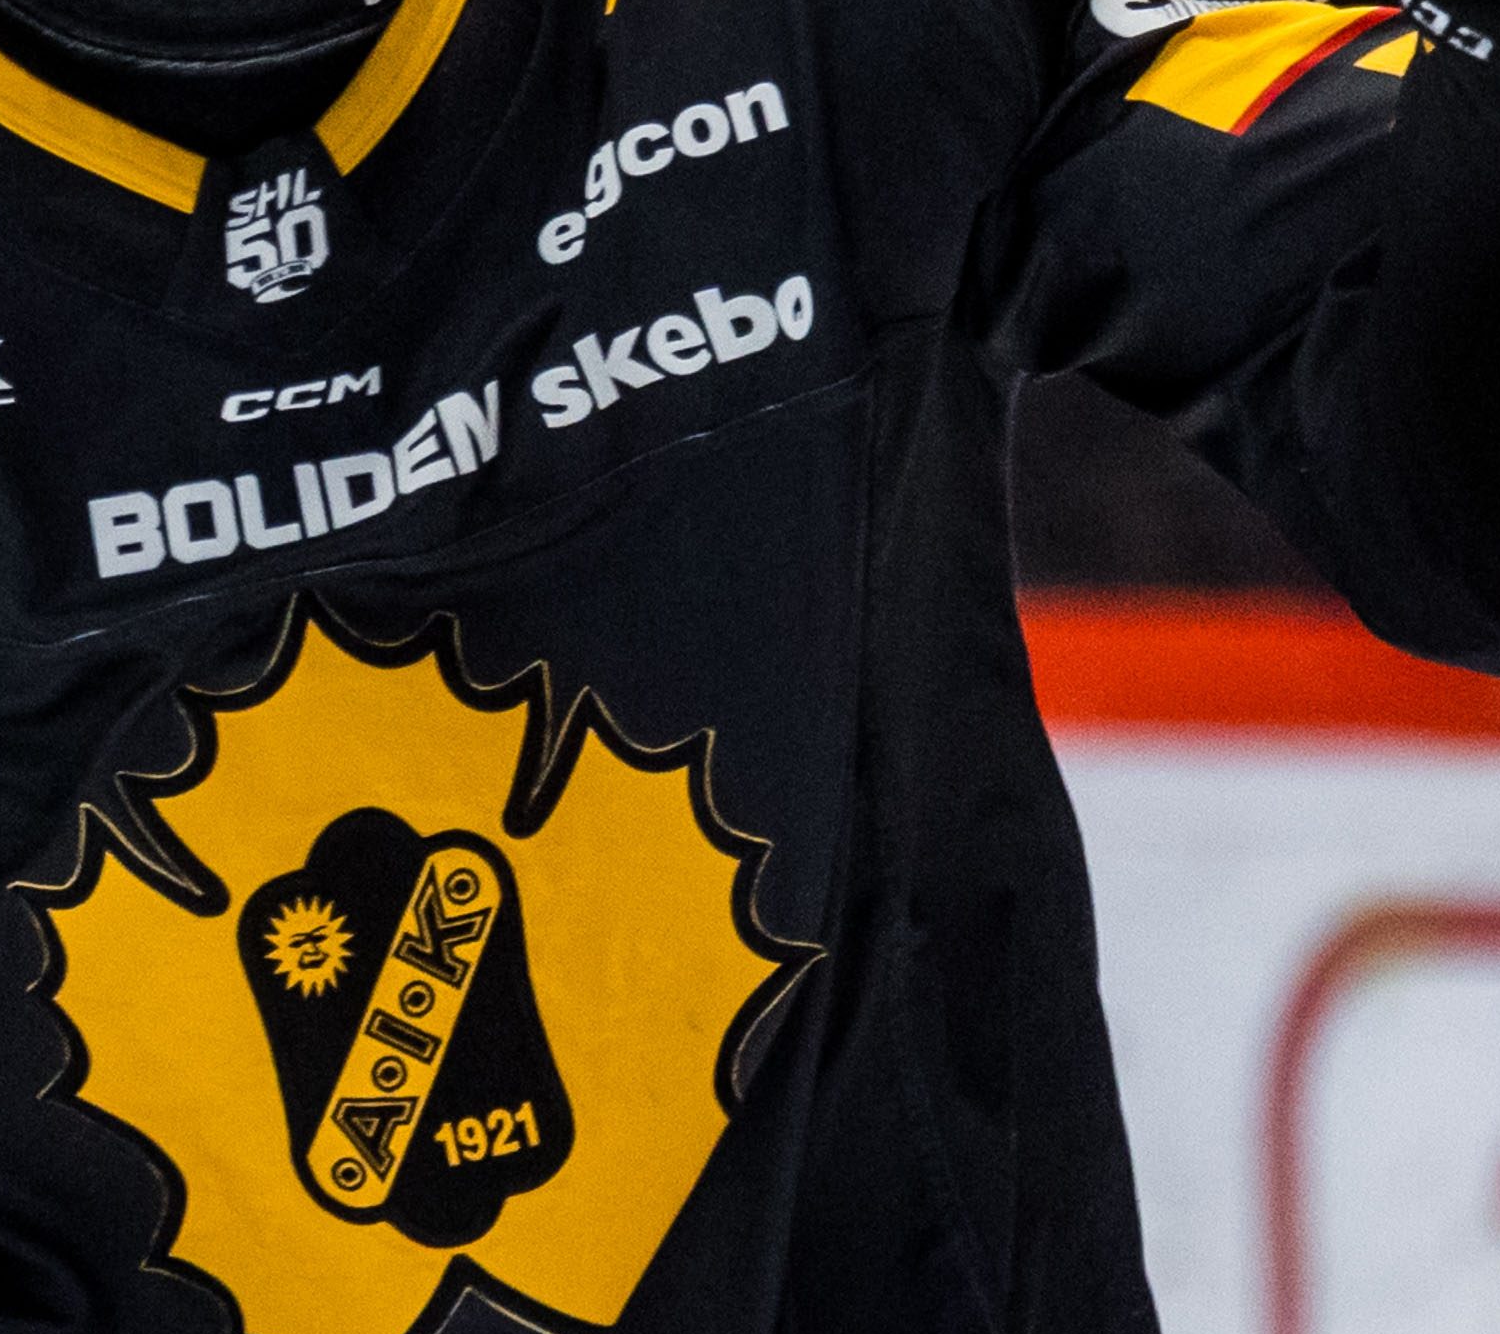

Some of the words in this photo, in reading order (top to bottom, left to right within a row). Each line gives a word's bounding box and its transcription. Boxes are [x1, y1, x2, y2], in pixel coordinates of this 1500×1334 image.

[226, 167, 322, 228] SHL
[536, 80, 790, 265] egcon
[225, 204, 330, 290] 50
[88, 380, 500, 578] BOLIDEN
[531, 275, 814, 430] skebo
[220, 366, 381, 422] CCM
[434, 1101, 542, 1169] 1921
